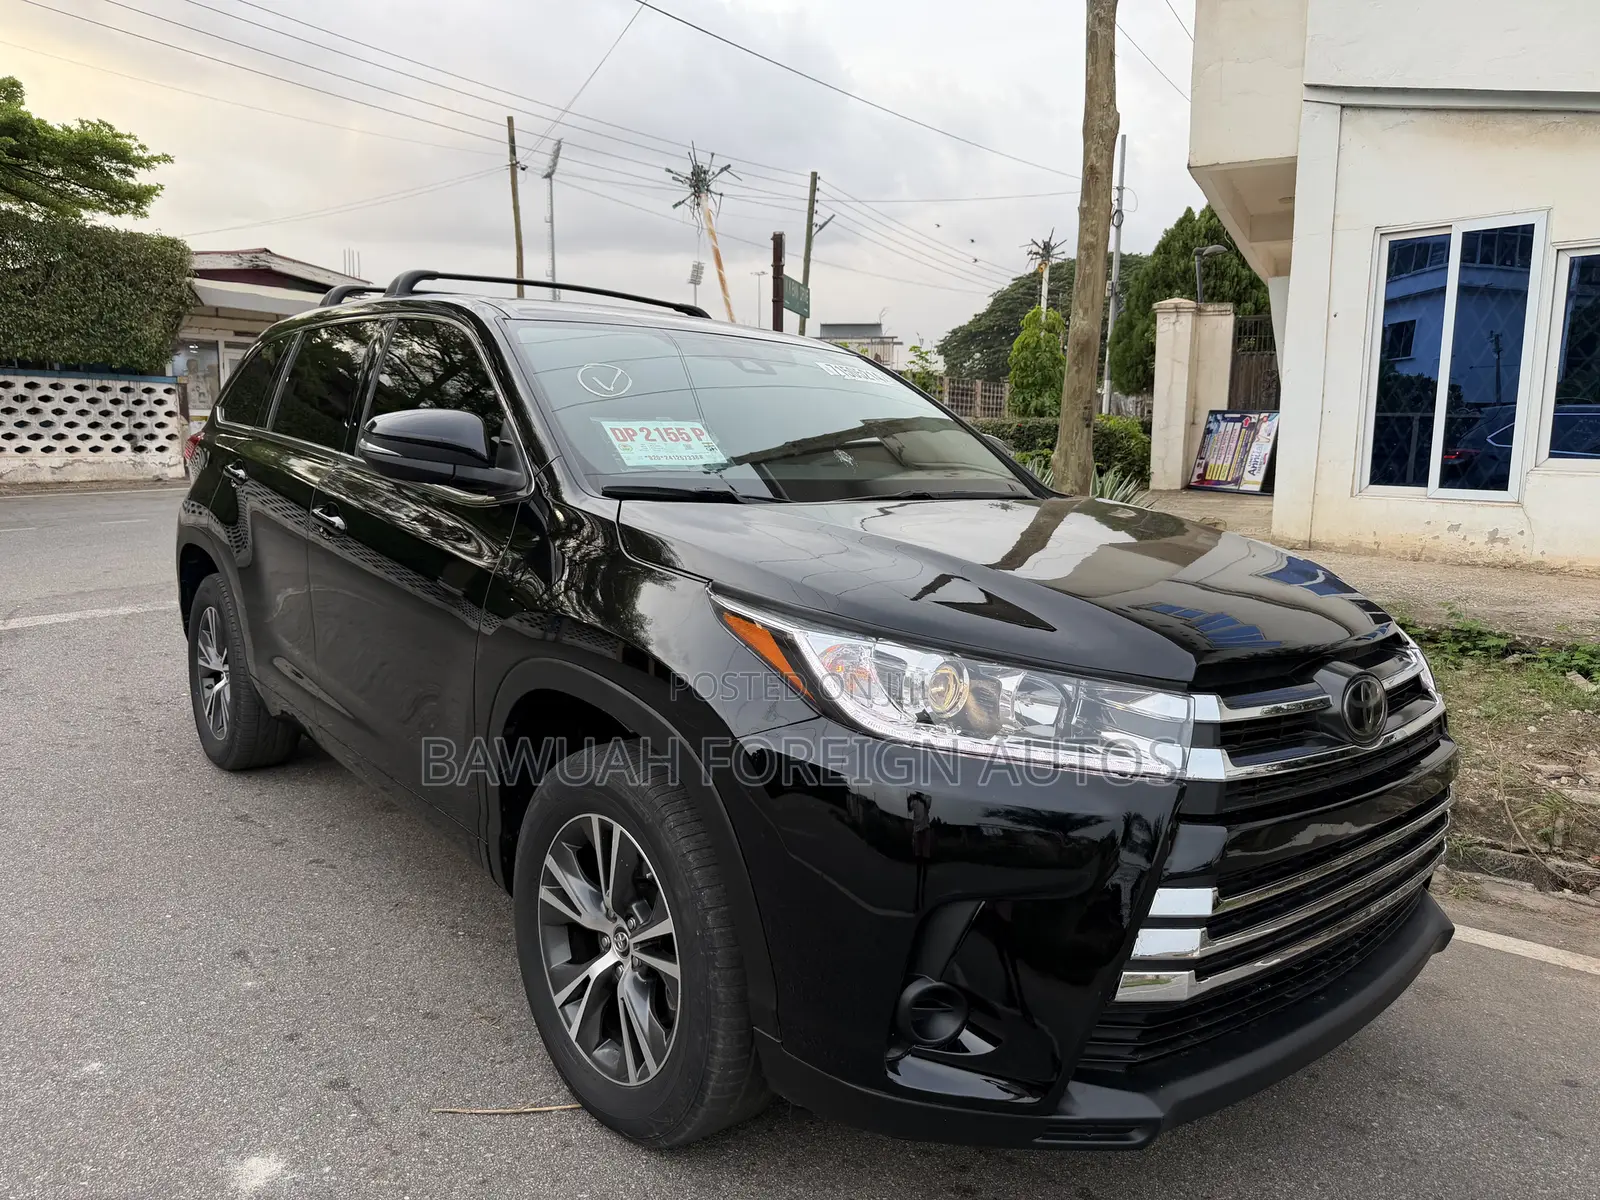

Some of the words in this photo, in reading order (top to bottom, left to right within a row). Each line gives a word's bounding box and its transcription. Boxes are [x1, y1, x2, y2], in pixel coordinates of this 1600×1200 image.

[609, 427, 638, 442] DP
[639, 427, 692, 442] 2155
[690, 427, 705, 441] P
